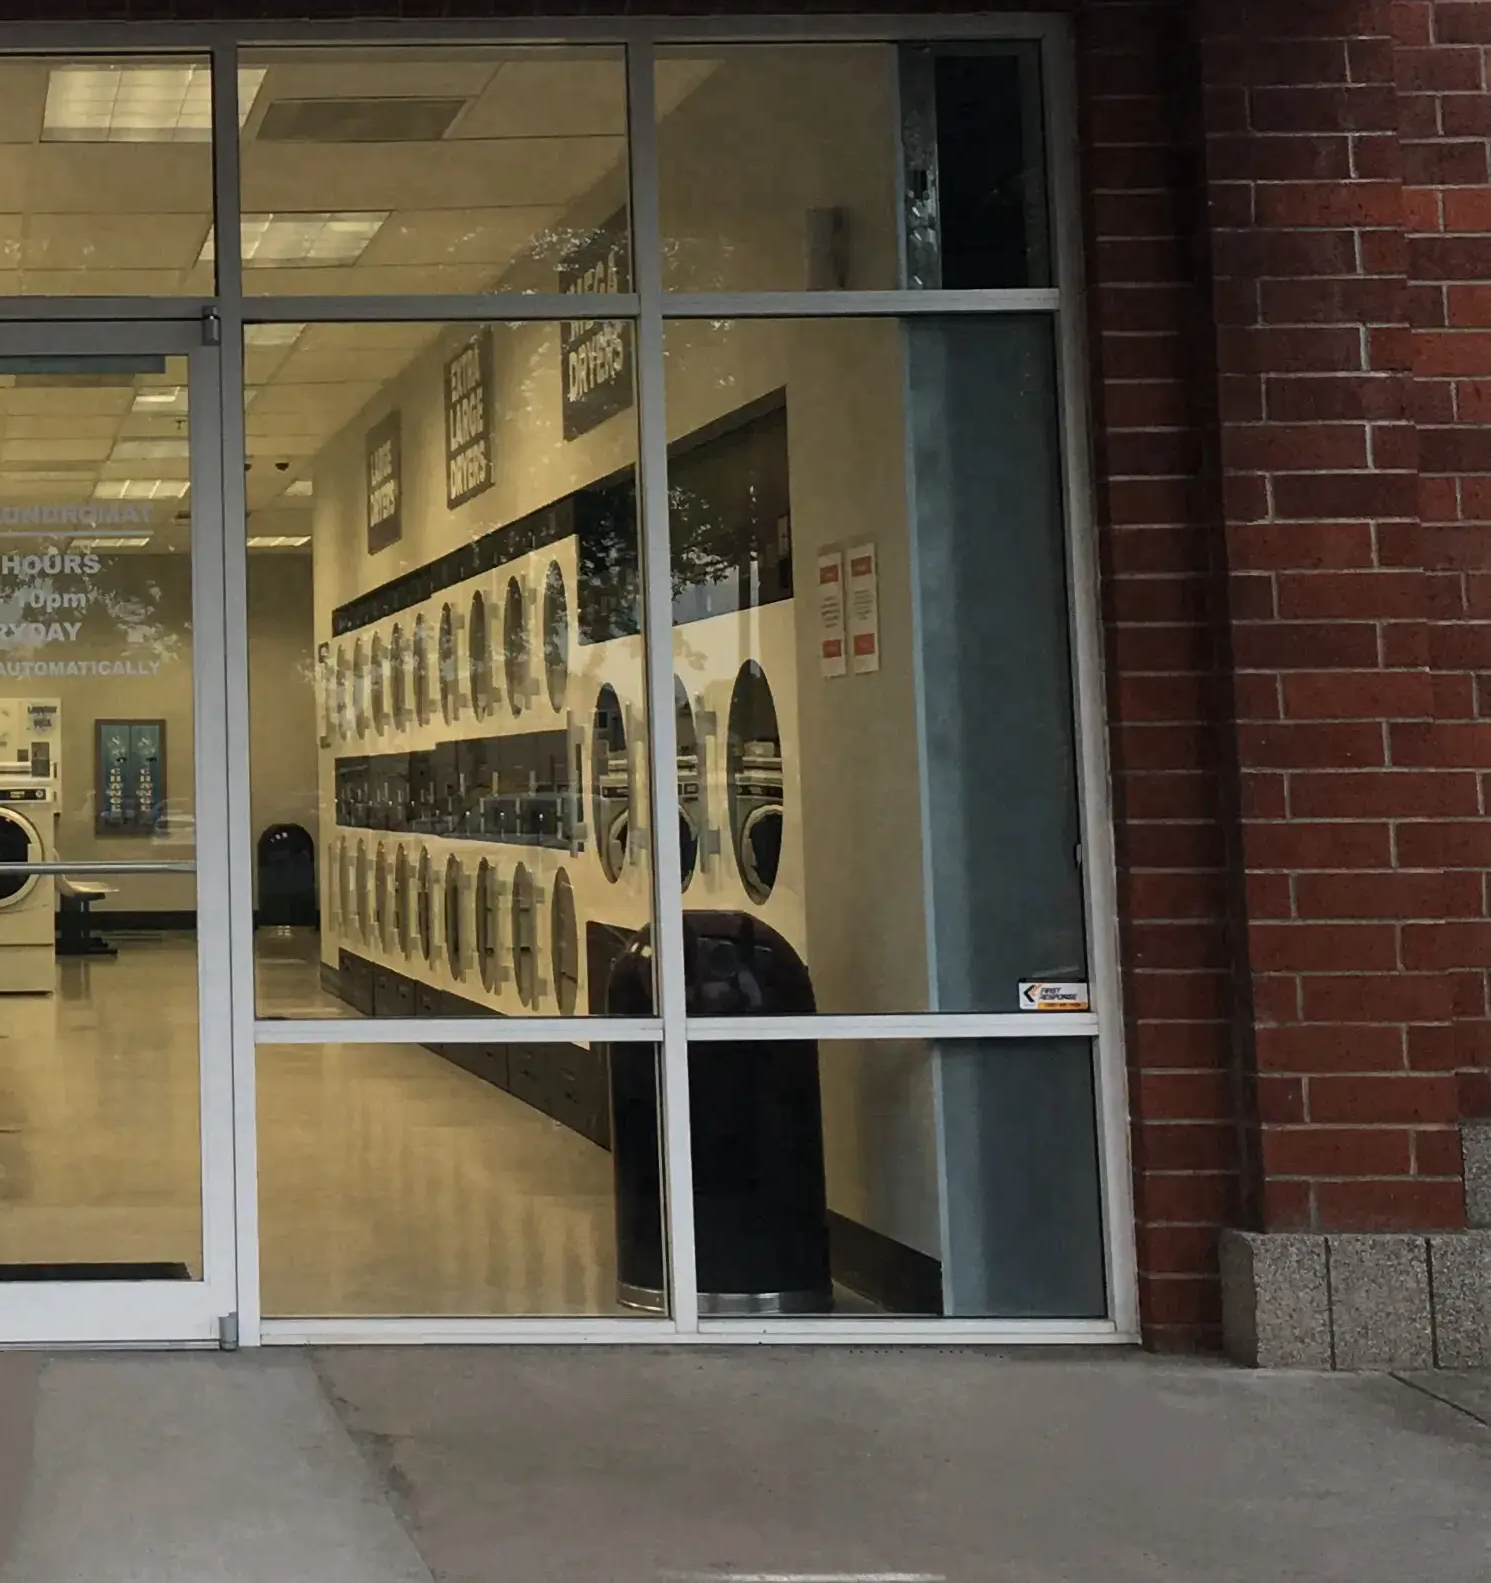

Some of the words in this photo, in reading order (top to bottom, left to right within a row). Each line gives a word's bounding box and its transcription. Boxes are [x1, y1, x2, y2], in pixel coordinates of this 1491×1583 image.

[568, 334, 624, 401] DRYERS
[450, 386, 484, 452] LARGE
[450, 439, 486, 501] DRYERS
[1, 554, 102, 575] HOURS
